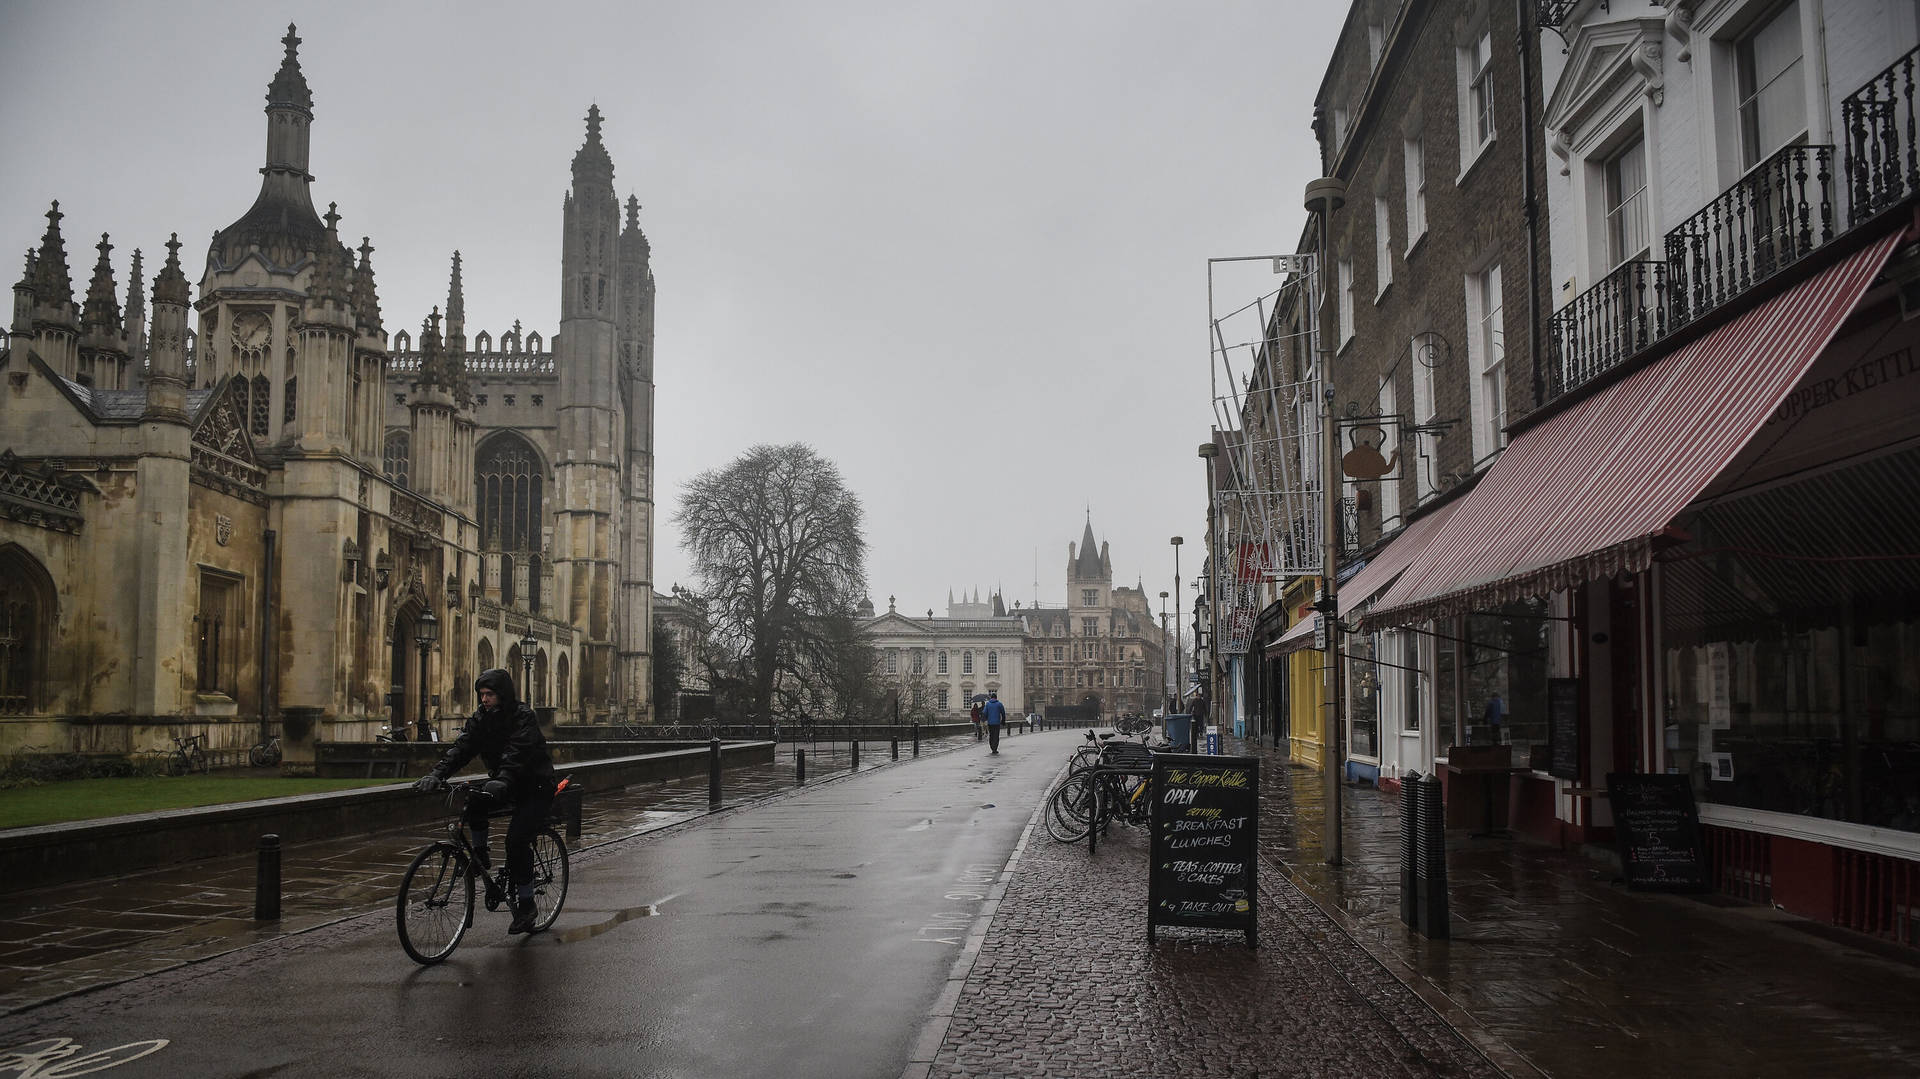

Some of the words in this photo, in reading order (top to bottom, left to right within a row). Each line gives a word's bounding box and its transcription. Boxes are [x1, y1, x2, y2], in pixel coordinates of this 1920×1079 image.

[1167, 769, 1188, 784] The
[1189, 770, 1219, 788] Copper
[1216, 769, 1247, 788] Kettle
[1164, 788, 1199, 805] OPEN
[1186, 807, 1222, 821] serving
[1172, 817, 1248, 832] BREAKFAST
[1171, 834, 1231, 849] LUNCHES
[1173, 861, 1199, 873] TEAS
[1177, 873, 1186, 882] &
[1187, 873, 1224, 885] CAKES
[912, 912, 973, 944] ONLY
